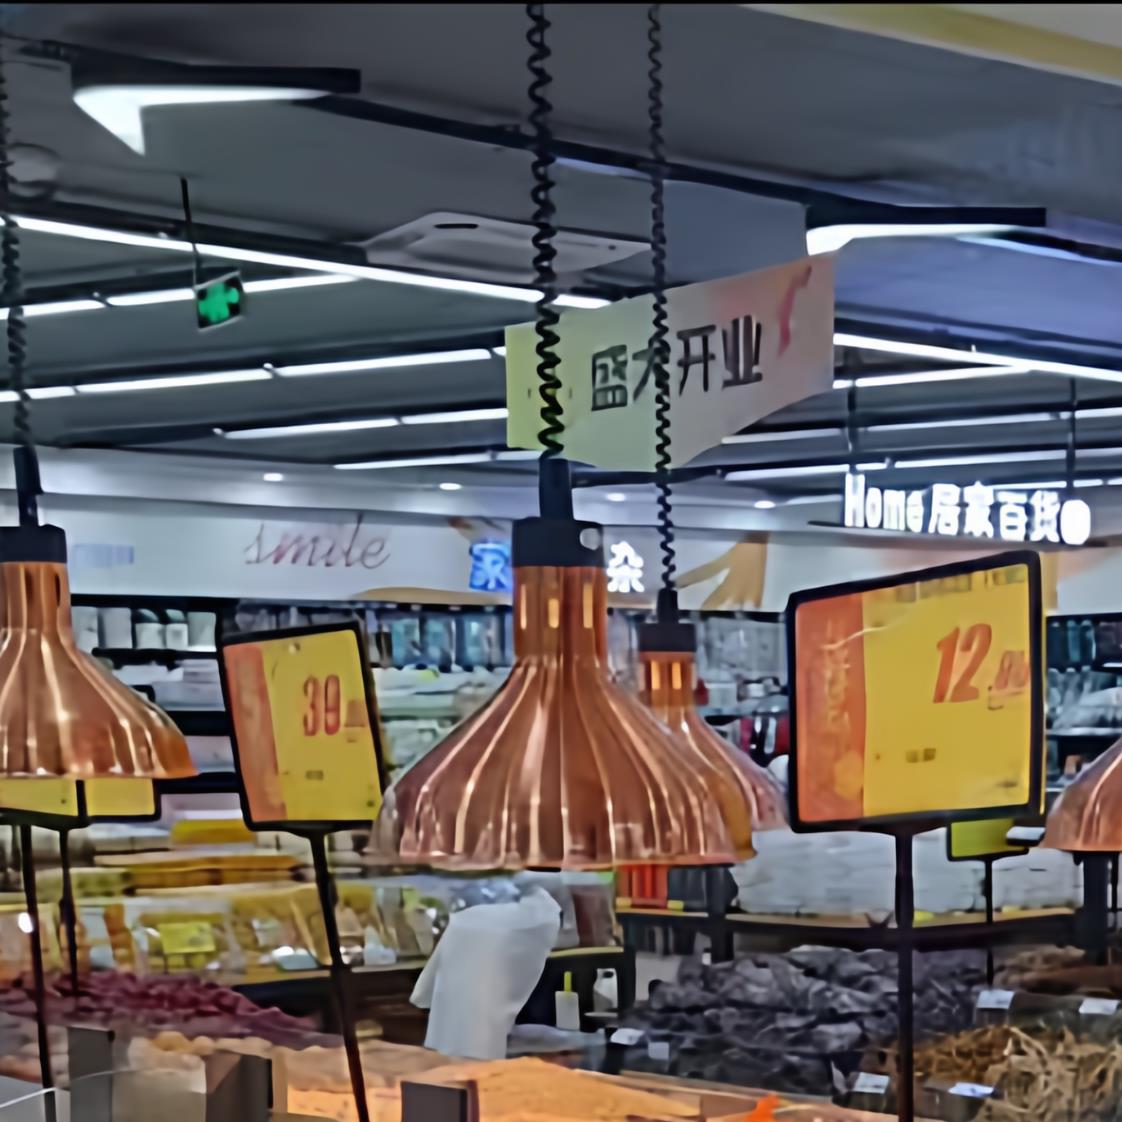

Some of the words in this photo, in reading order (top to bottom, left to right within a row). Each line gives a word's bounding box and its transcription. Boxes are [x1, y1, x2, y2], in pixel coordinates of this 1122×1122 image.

[591, 314, 763, 411] 盛大开业
[844, 473, 924, 533] Home
[245, 512, 391, 569] smile
